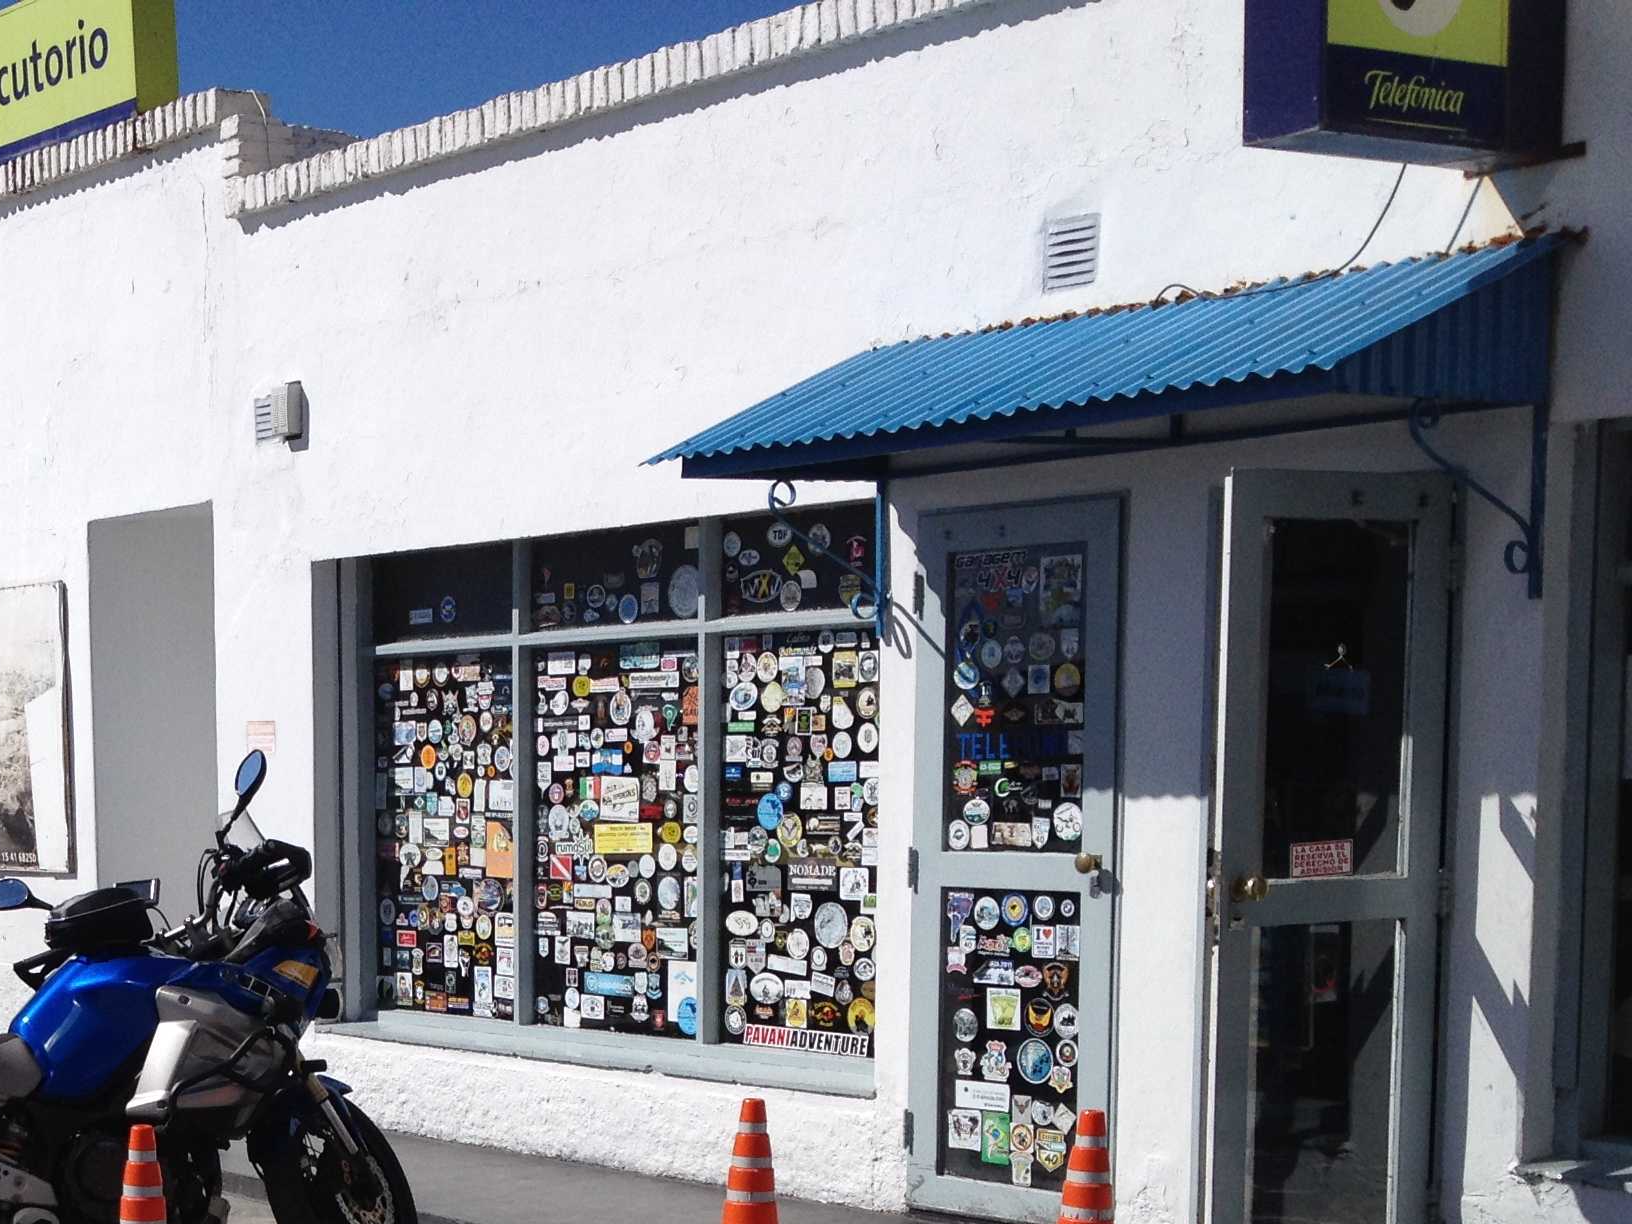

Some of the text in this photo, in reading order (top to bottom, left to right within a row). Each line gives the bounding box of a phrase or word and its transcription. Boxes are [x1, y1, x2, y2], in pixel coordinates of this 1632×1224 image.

[1294, 852, 1334, 861] RESERVA
[1294, 857, 1348, 868] DERECHO DE
[788, 864, 837, 876] NOMADE
[1044, 1153, 1059, 1164] 40
